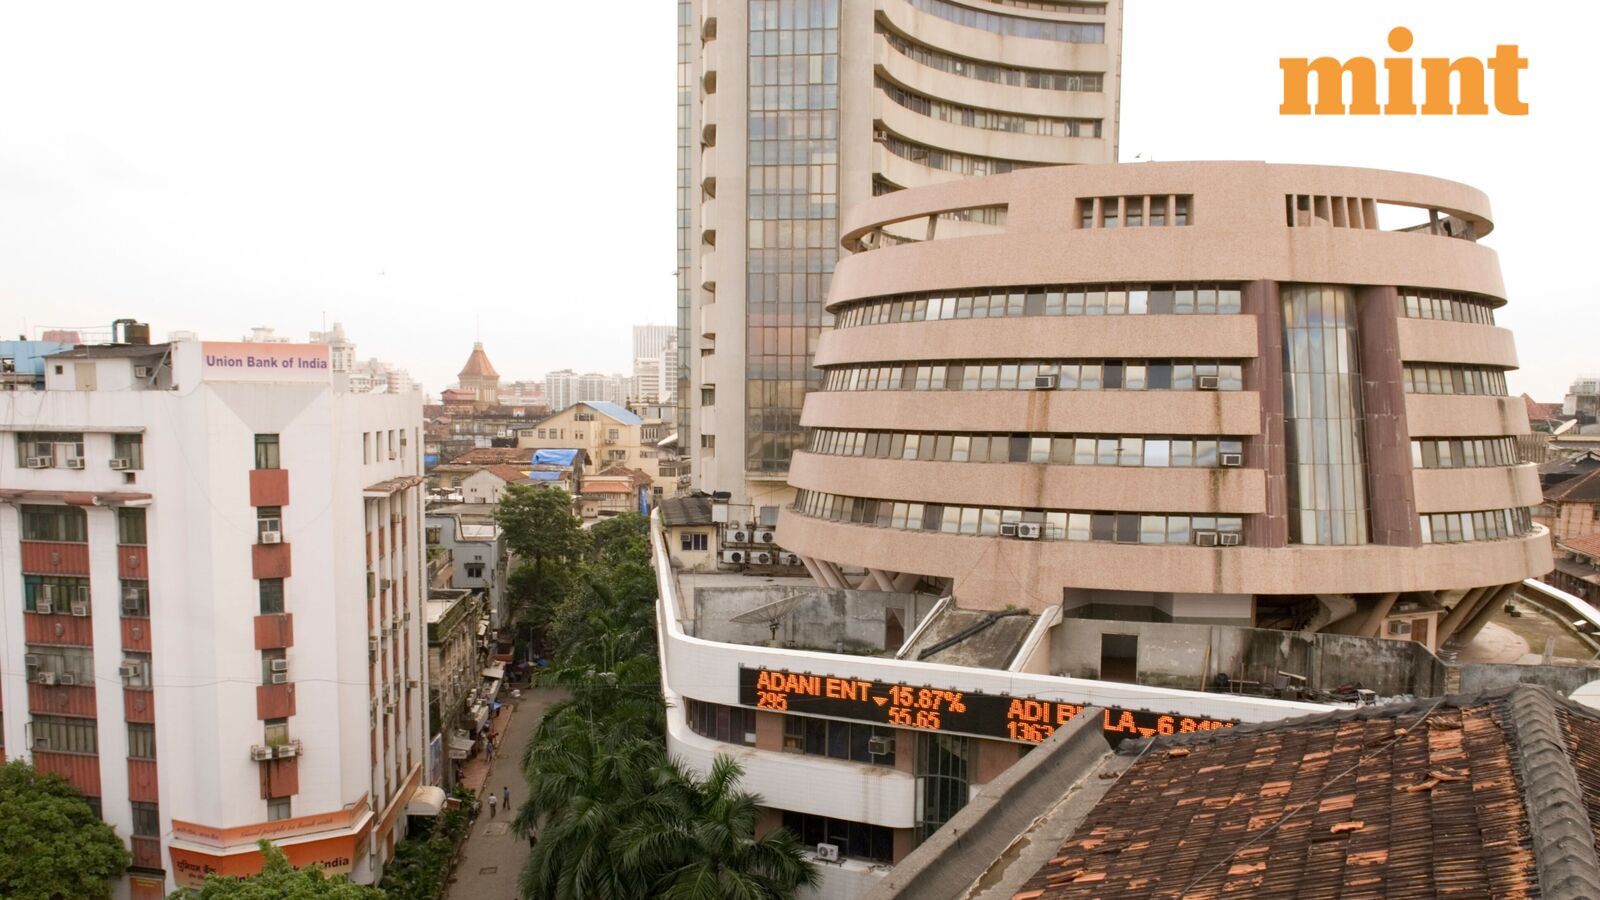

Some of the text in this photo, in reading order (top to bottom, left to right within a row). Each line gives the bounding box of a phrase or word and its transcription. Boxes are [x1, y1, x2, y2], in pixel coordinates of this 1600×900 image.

[206, 355, 328, 369] Union Bank of India
[757, 671, 967, 713] ADANI ENT 15.87%
[757, 691, 941, 730] 295 55.65
[1007, 699, 1050, 722] ADI
[1057, 703, 1137, 733] BLA
[320, 857, 350, 868] ndia
